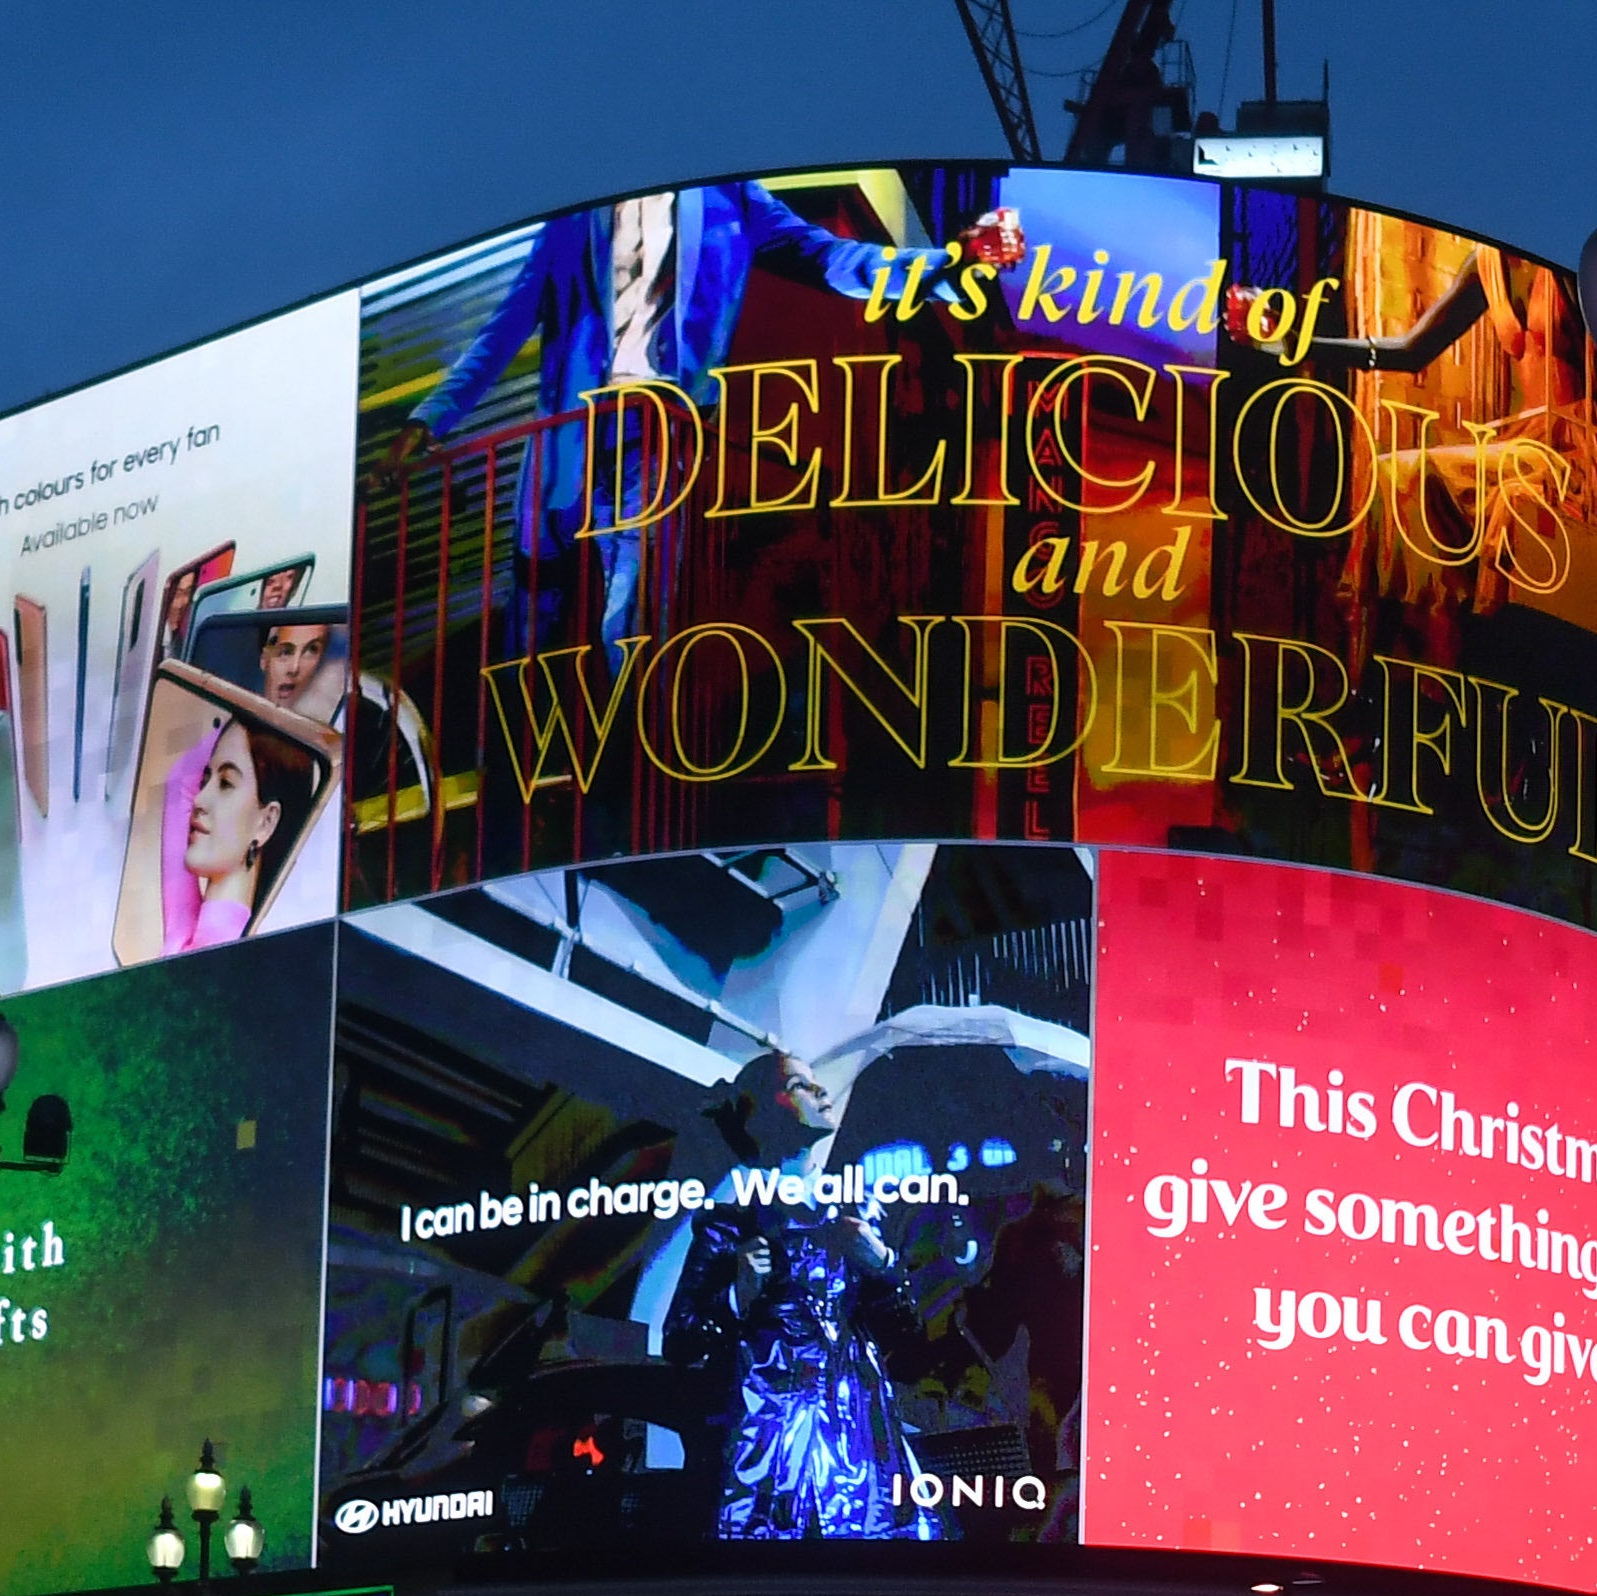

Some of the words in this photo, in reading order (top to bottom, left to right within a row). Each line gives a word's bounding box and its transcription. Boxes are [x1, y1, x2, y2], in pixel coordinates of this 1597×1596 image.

[863, 242, 996, 322] it's
[1018, 244, 1228, 334] kind
[1247, 276, 1339, 366] of
[14, 472, 84, 510] colours
[91, 458, 118, 485] for
[123, 438, 180, 473] every
[188, 424, 220, 452] fan
[575, 353, 1571, 594] DELICIOUS
[21, 511, 108, 556] Available
[114, 494, 160, 526] now
[1011, 525, 1192, 602] and
[1224, 1057, 1377, 1141] This
[401, 1205, 411, 1242] I
[415, 1202, 474, 1239] can
[479, 1190, 524, 1230] be
[529, 1181, 561, 1223] in
[567, 1177, 715, 1220] charge.
[731, 1167, 805, 1207] We
[813, 1163, 864, 1204] all
[873, 1173, 970, 1206] can.
[1143, 1157, 1287, 1238] give
[1253, 1284, 1387, 1351] you
[1398, 1303, 1516, 1365] can
[382, 1490, 494, 1527] HYUNDAI
[891, 1473, 1046, 1511] IONIQ
